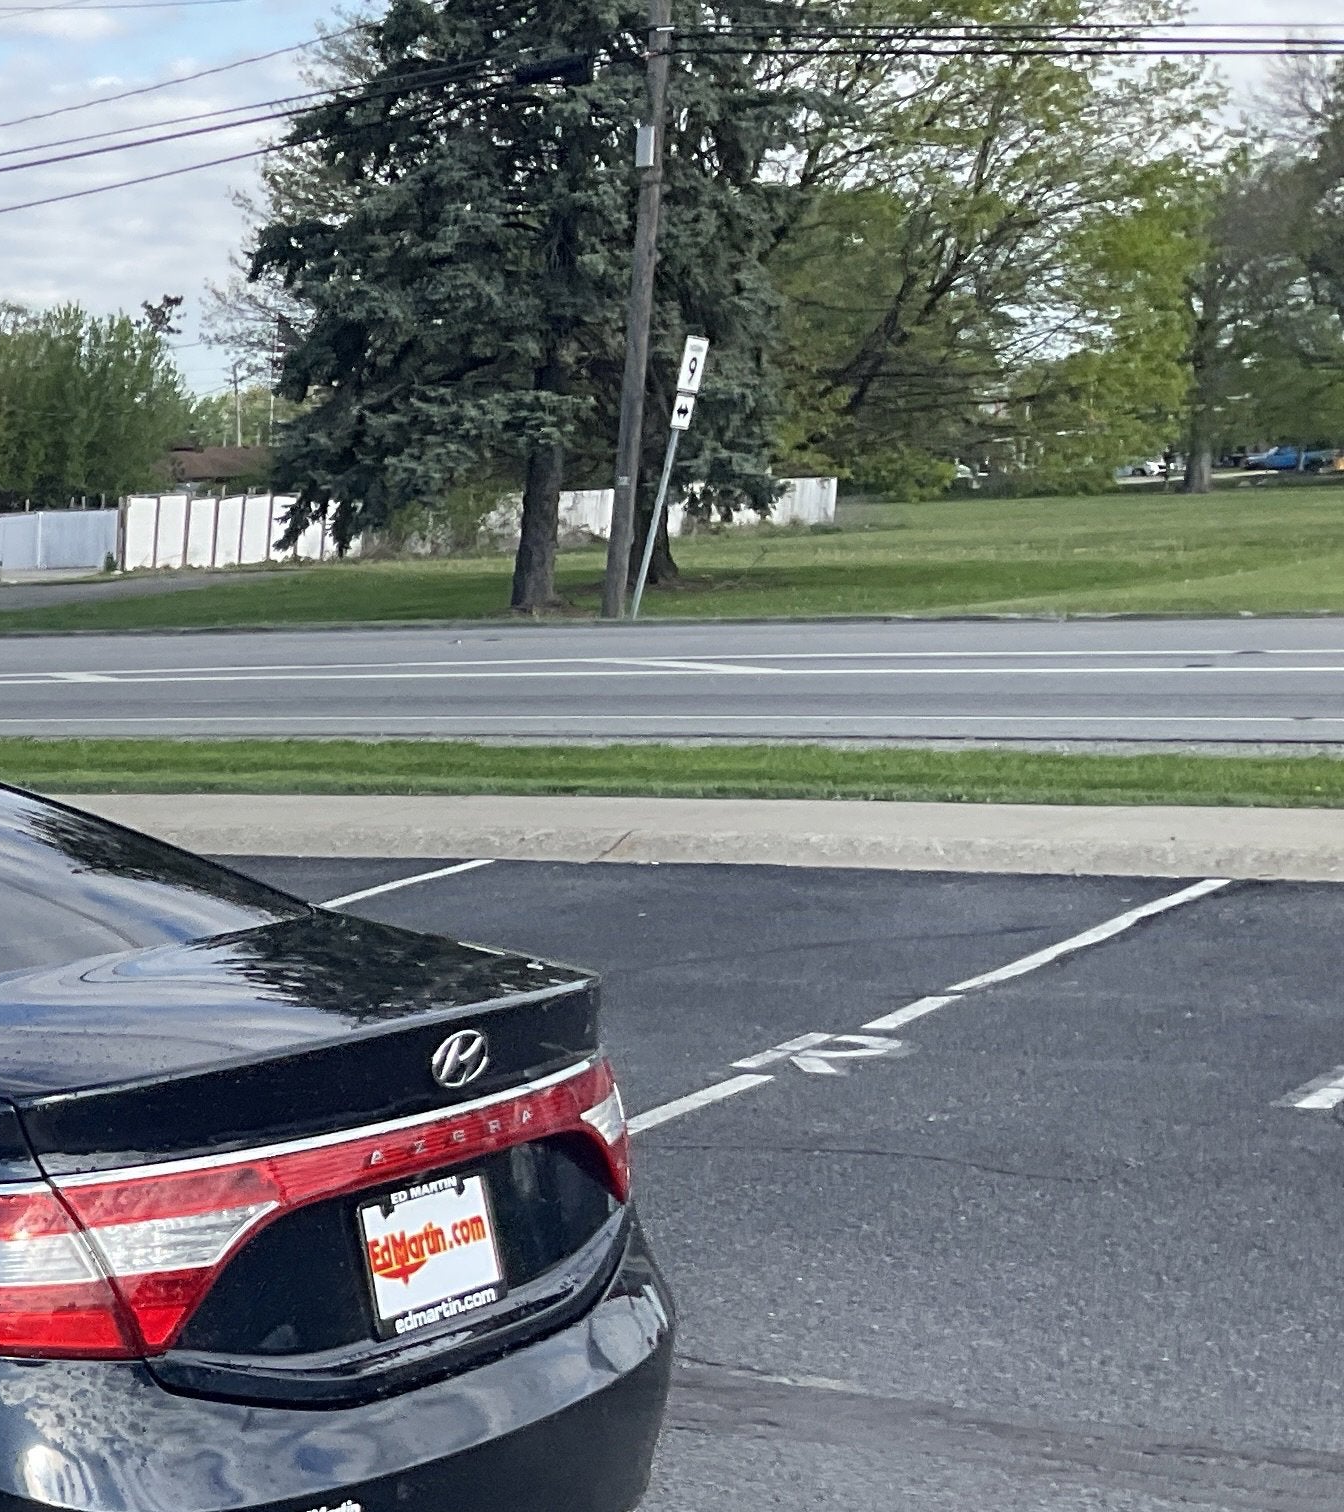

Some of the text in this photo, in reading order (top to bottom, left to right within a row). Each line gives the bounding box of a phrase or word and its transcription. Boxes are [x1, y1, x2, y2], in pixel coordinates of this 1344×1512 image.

[688, 356, 698, 385] 9
[369, 1108, 534, 1165] AZERA
[390, 1175, 459, 1204] ED MARTIN
[367, 1214, 487, 1274] EdMartin.com
[395, 1287, 497, 1334] edmartin.com
